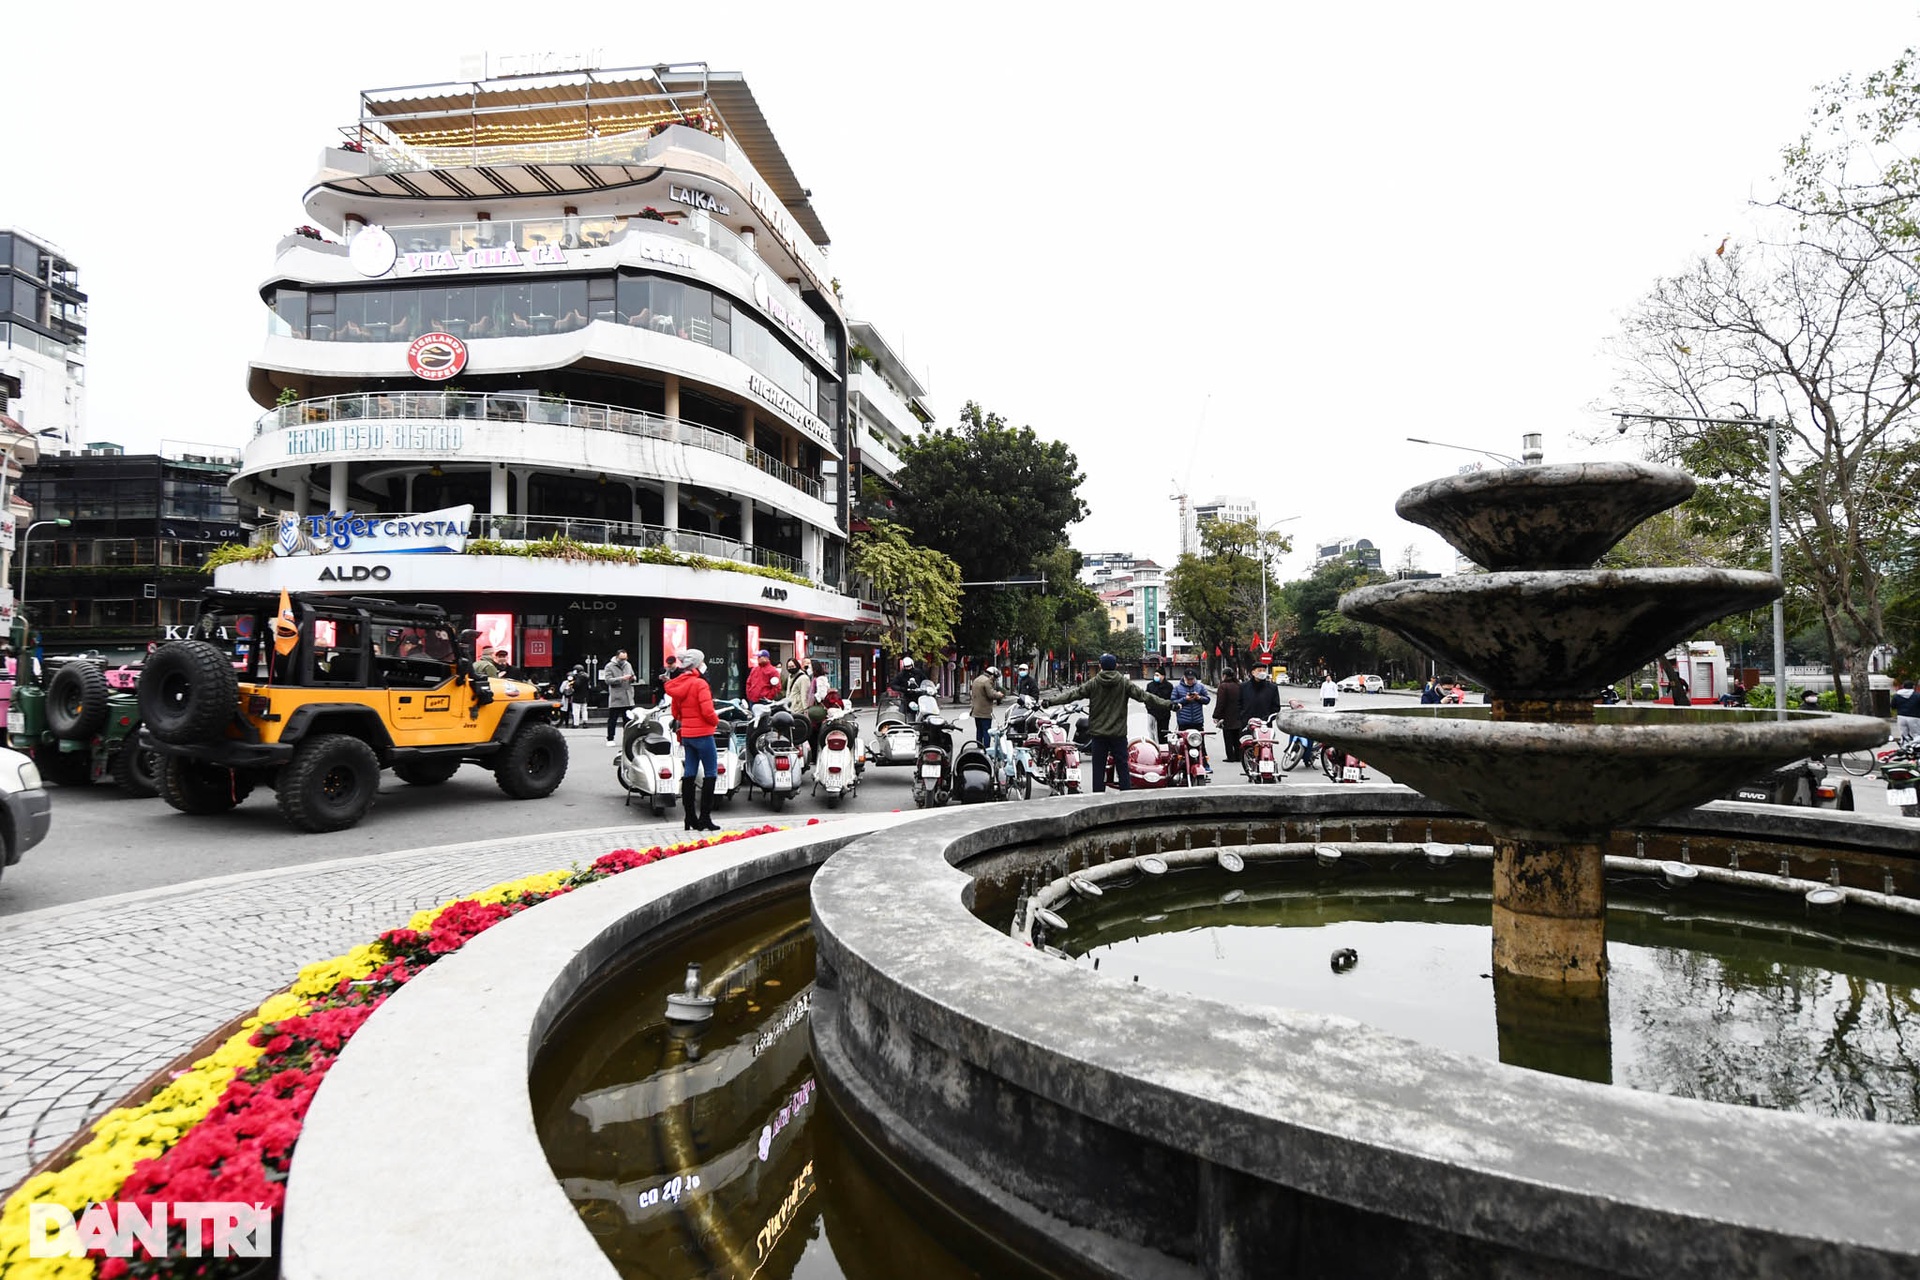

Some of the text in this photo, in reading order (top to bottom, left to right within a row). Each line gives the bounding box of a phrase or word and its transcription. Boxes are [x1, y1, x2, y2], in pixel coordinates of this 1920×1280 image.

[669, 184, 718, 212] LAIKA
[405, 250, 460, 272] VUA
[409, 335, 463, 356] HIGHLANDS
[415, 365, 458, 378] COFFEE
[341, 424, 384, 450] 1930
[391, 424, 463, 451] BISTRO
[306, 510, 471, 550] Tiger CRYSTAL
[318, 565, 392, 581] ALDO
[761, 585, 788, 601] ALDO
[569, 601, 617, 610] ALDO
